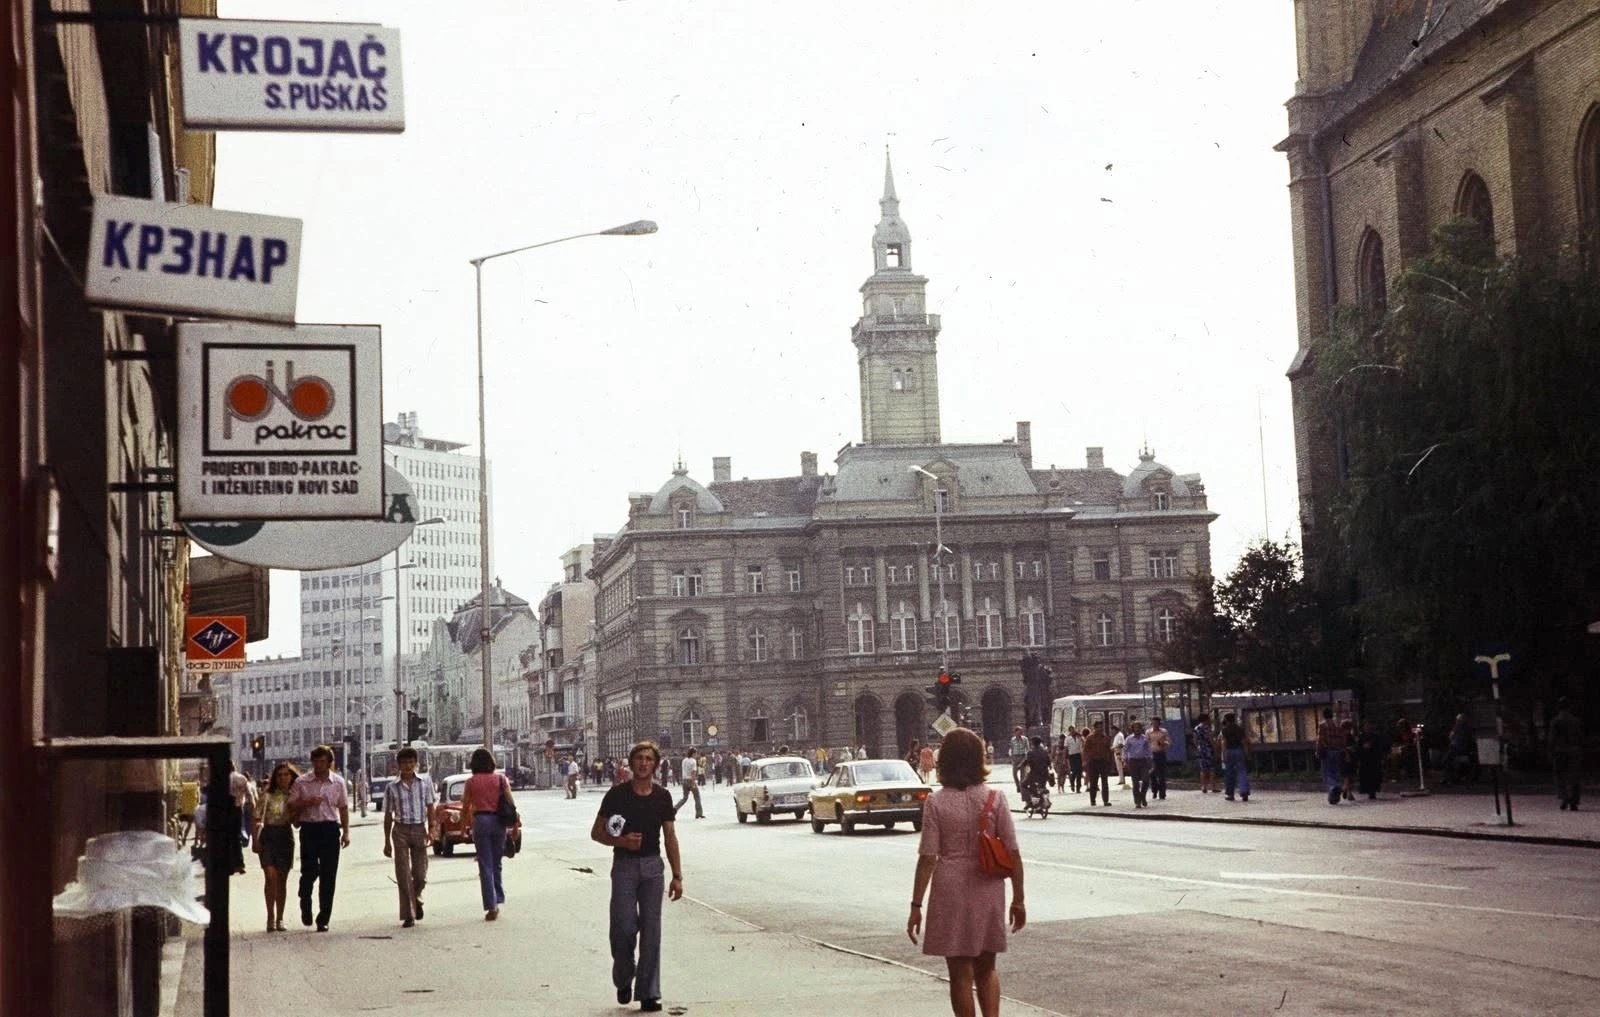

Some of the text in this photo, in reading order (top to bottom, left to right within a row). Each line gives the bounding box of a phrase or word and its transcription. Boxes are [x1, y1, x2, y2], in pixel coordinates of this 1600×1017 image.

[197, 32, 387, 80] KROJAČ
[264, 78, 387, 112] S.PUŠKAŠ
[103, 219, 289, 284] КРЗНАР
[255, 420, 346, 445] pakrac
[202, 460, 266, 476] PROJEKTNI
[202, 477, 360, 495] I INŽENJERING NOVI SAD
